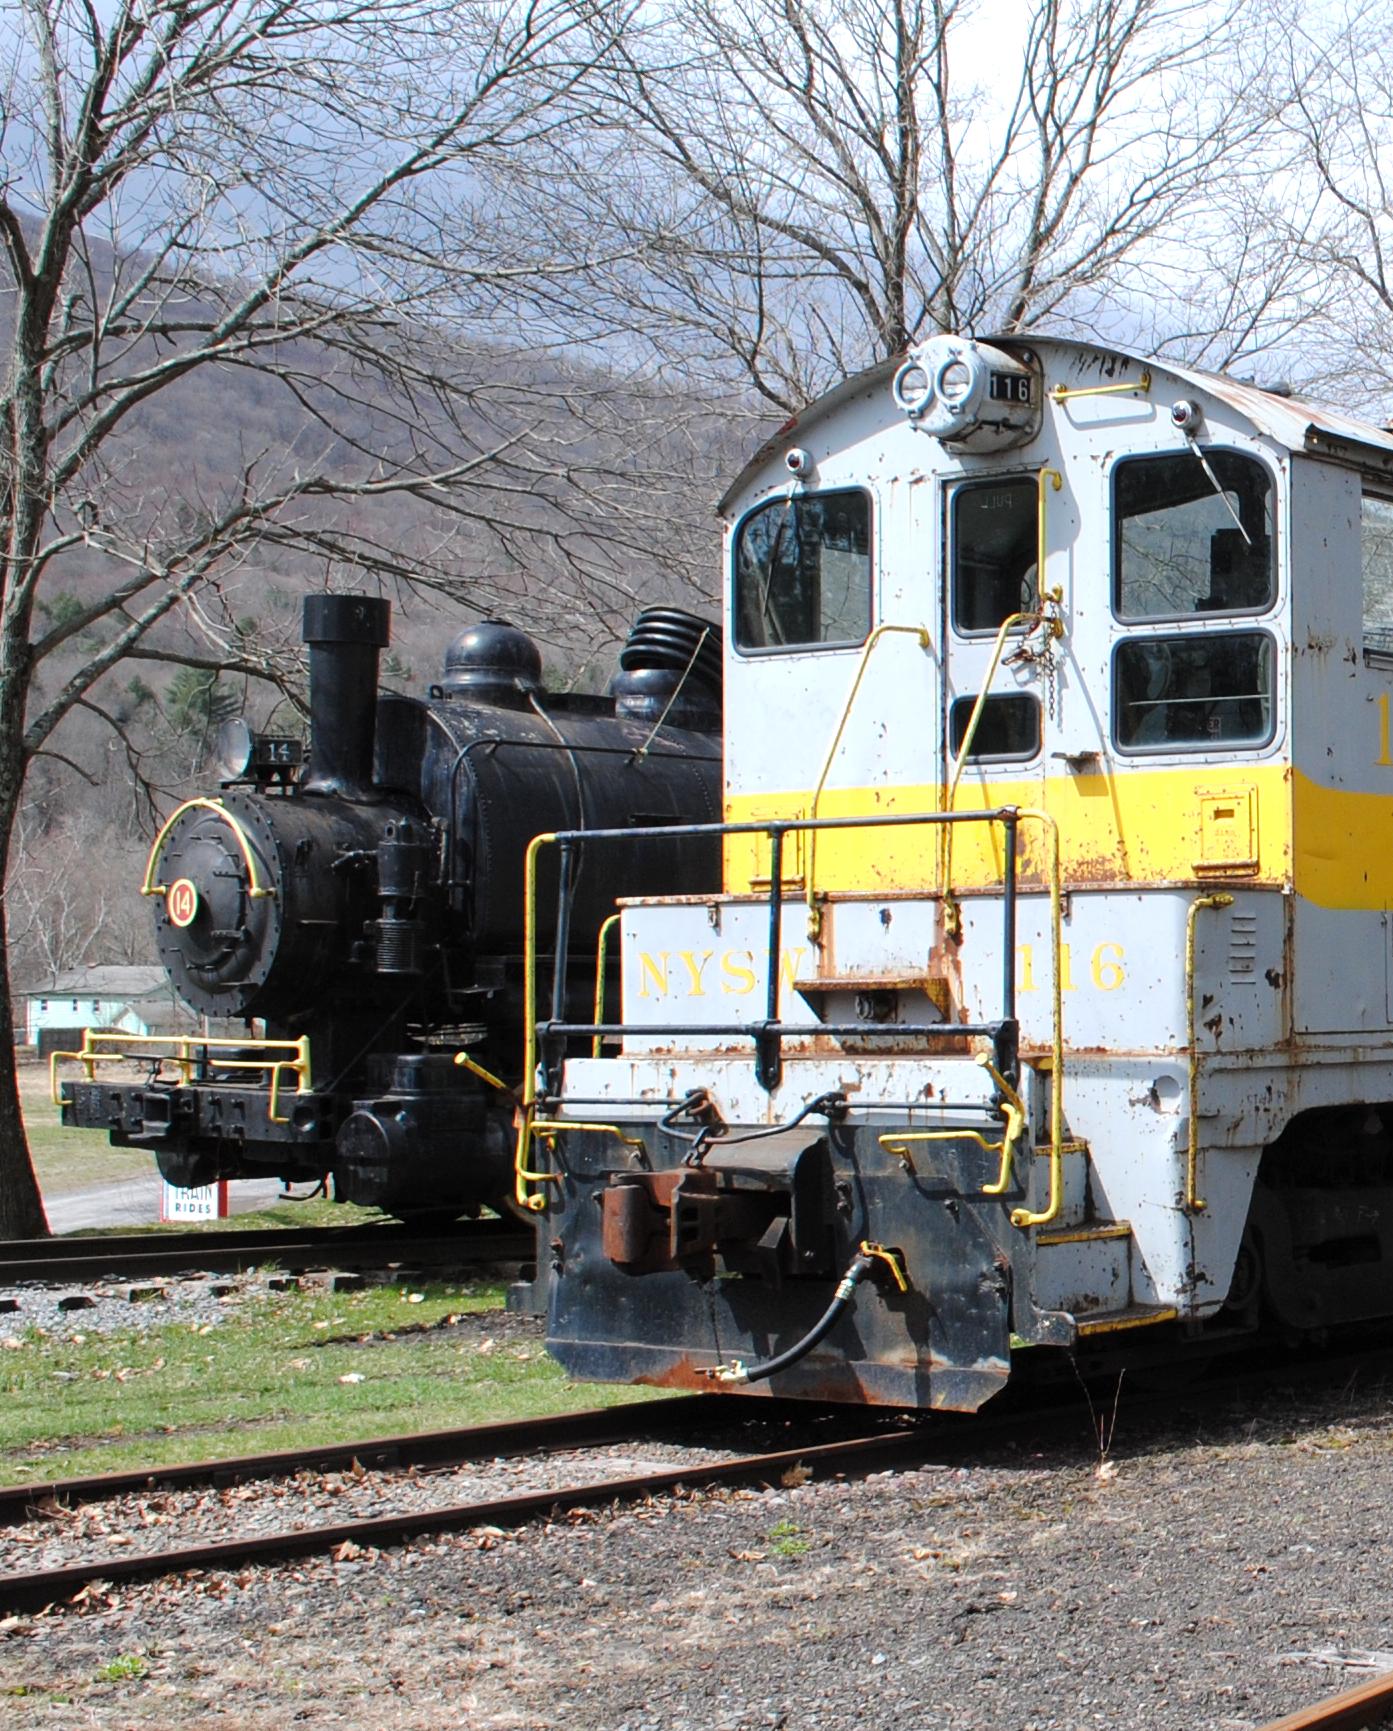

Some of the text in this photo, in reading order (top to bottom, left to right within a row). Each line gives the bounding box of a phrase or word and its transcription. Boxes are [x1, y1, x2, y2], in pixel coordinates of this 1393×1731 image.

[991, 375, 1028, 401] 116
[268, 743, 290, 761] 14
[176, 889, 191, 916] 14
[1014, 940, 1126, 993] 116
[175, 1202, 211, 1213] RIDES
